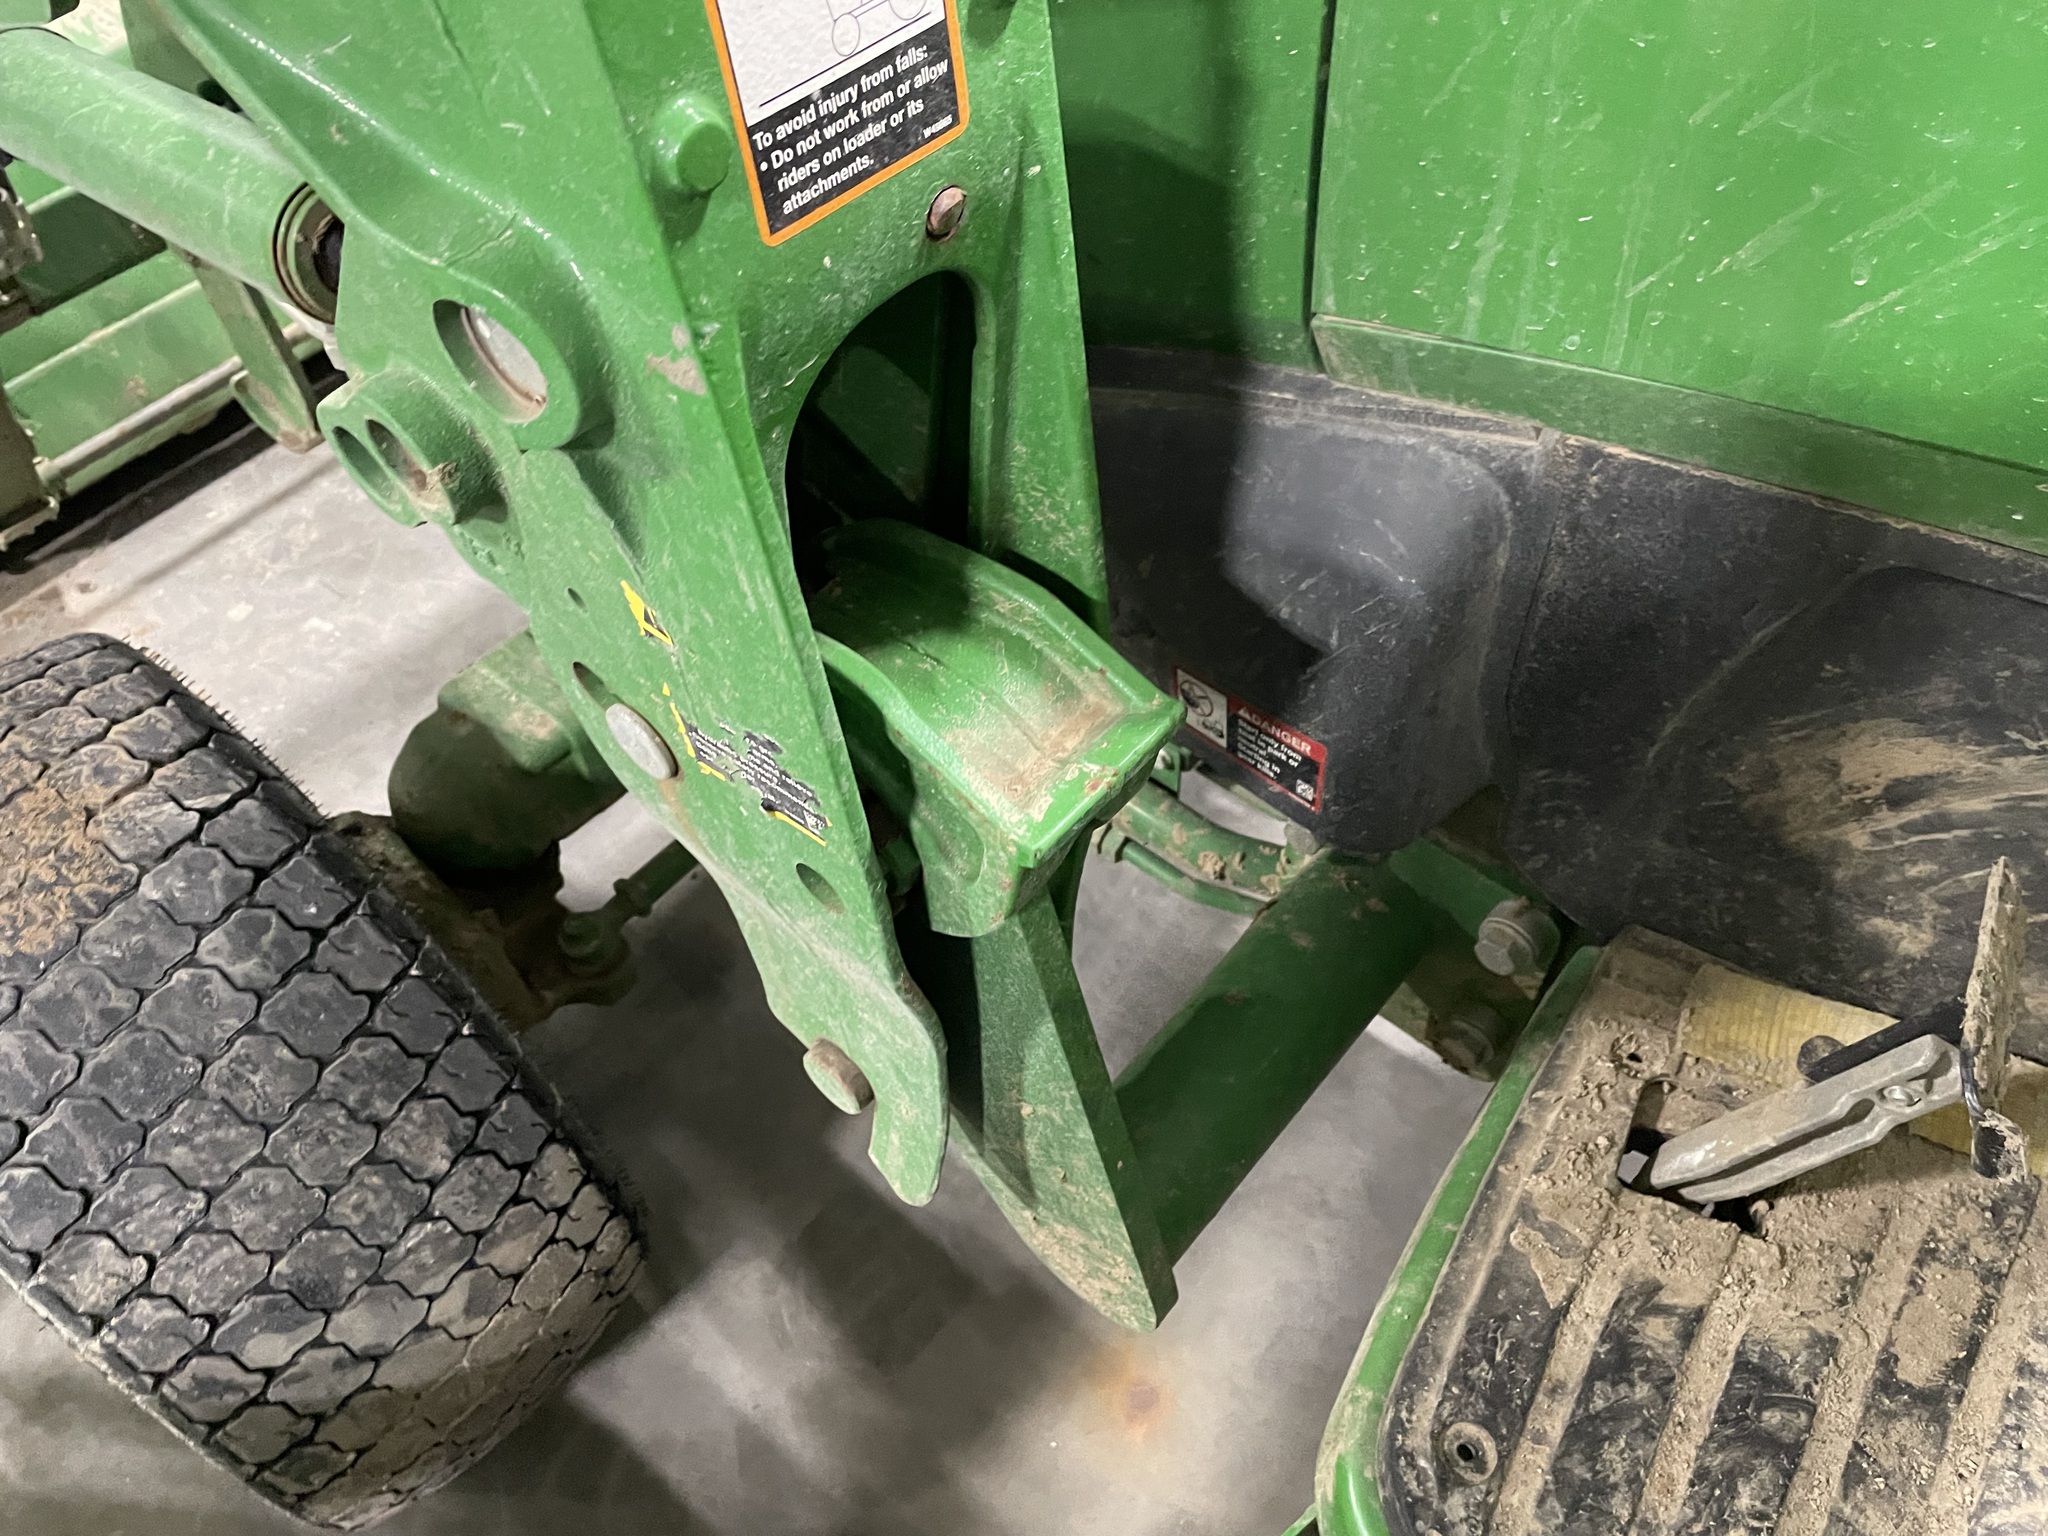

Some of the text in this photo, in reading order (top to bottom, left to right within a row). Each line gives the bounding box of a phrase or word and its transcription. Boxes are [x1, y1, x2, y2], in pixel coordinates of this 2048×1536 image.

[753, 45, 928, 151] To avoid injury from falls:
[770, 58, 948, 170] Do not work from or allow
[777, 158, 821, 192] riders
[823, 147, 843, 166] on
[843, 120, 888, 152] loader
[889, 110, 907, 129] or
[907, 97, 924, 119] its
[782, 152, 874, 215] attachments.
[1251, 714, 1311, 756] DANGER
[1280, 744, 1301, 761] from
